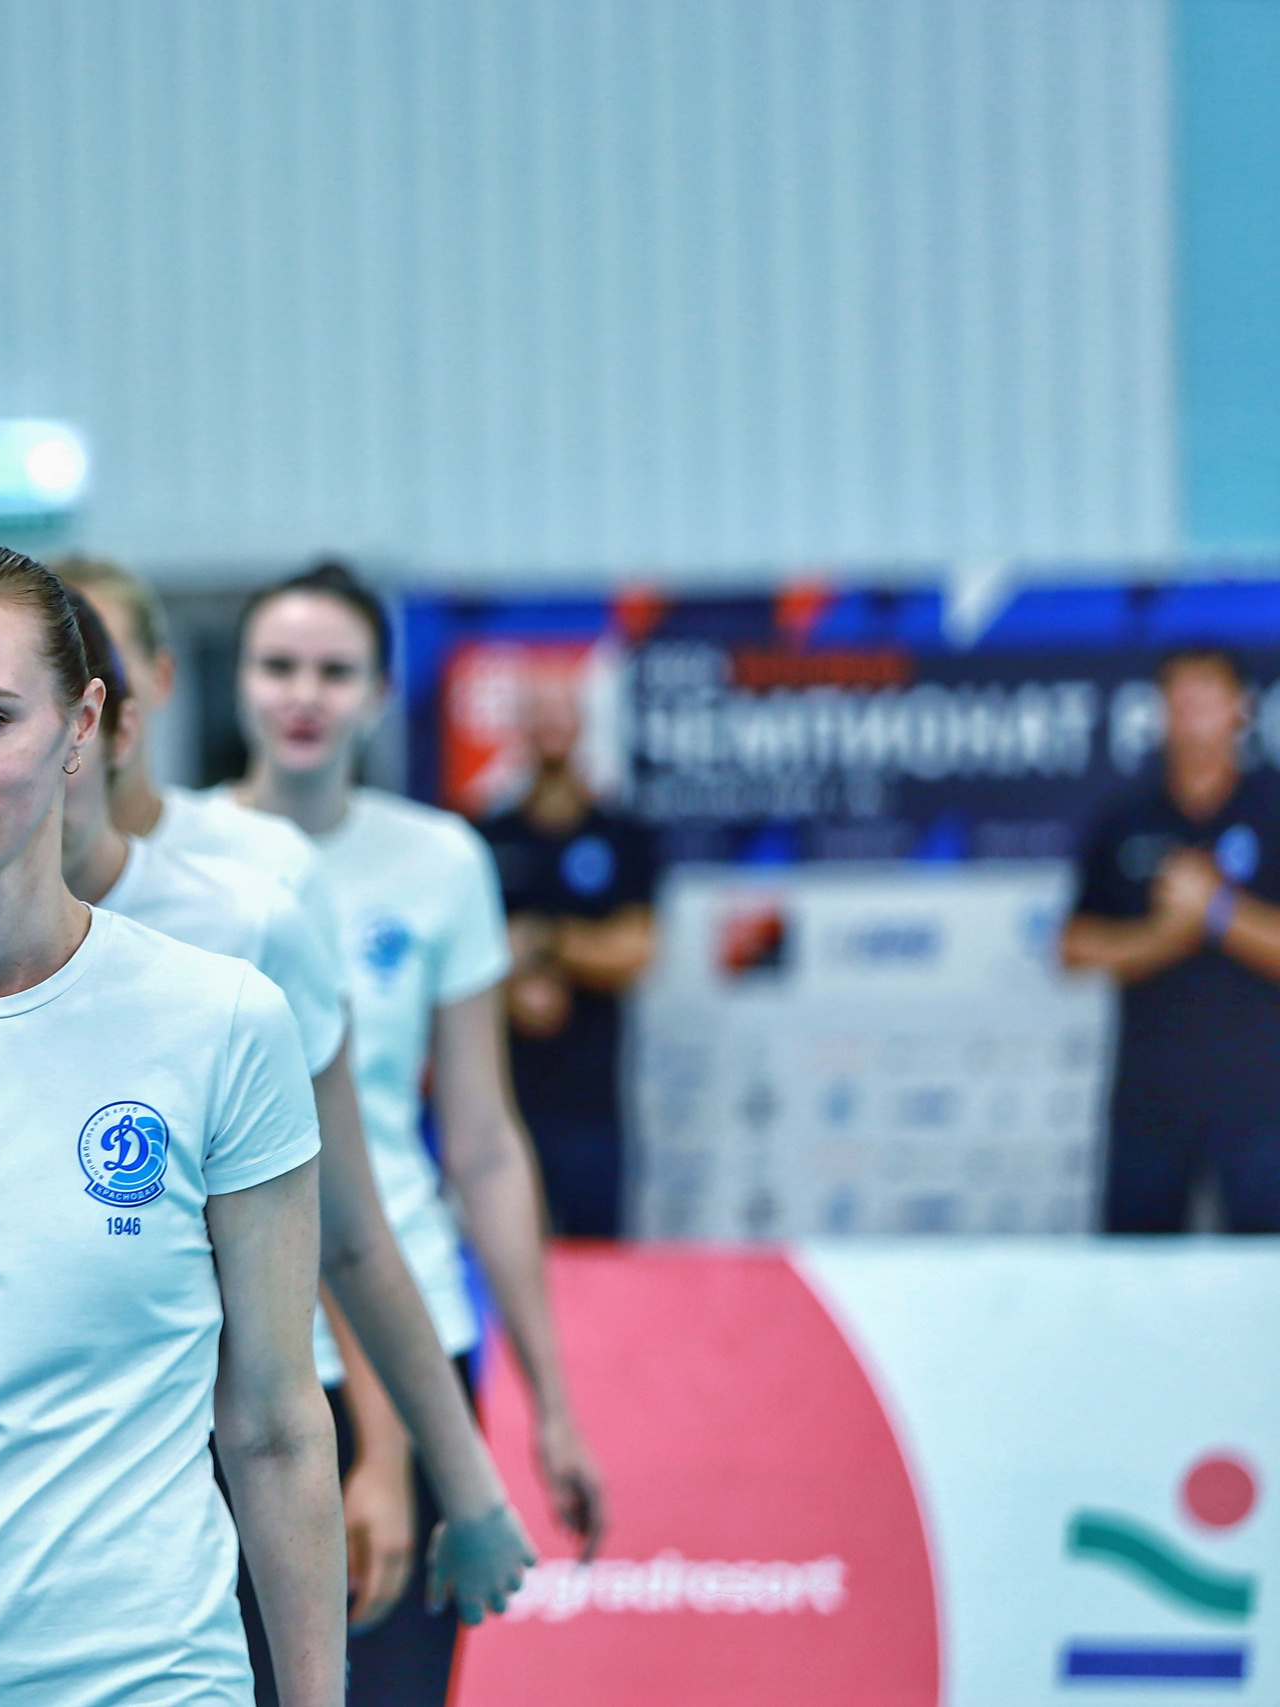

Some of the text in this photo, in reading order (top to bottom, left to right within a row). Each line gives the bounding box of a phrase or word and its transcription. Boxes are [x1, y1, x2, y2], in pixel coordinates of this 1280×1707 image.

[113, 1106, 138, 1114] клуб
[95, 1185, 157, 1200] КРАСНОДАР
[106, 1216, 141, 1236] 1946
